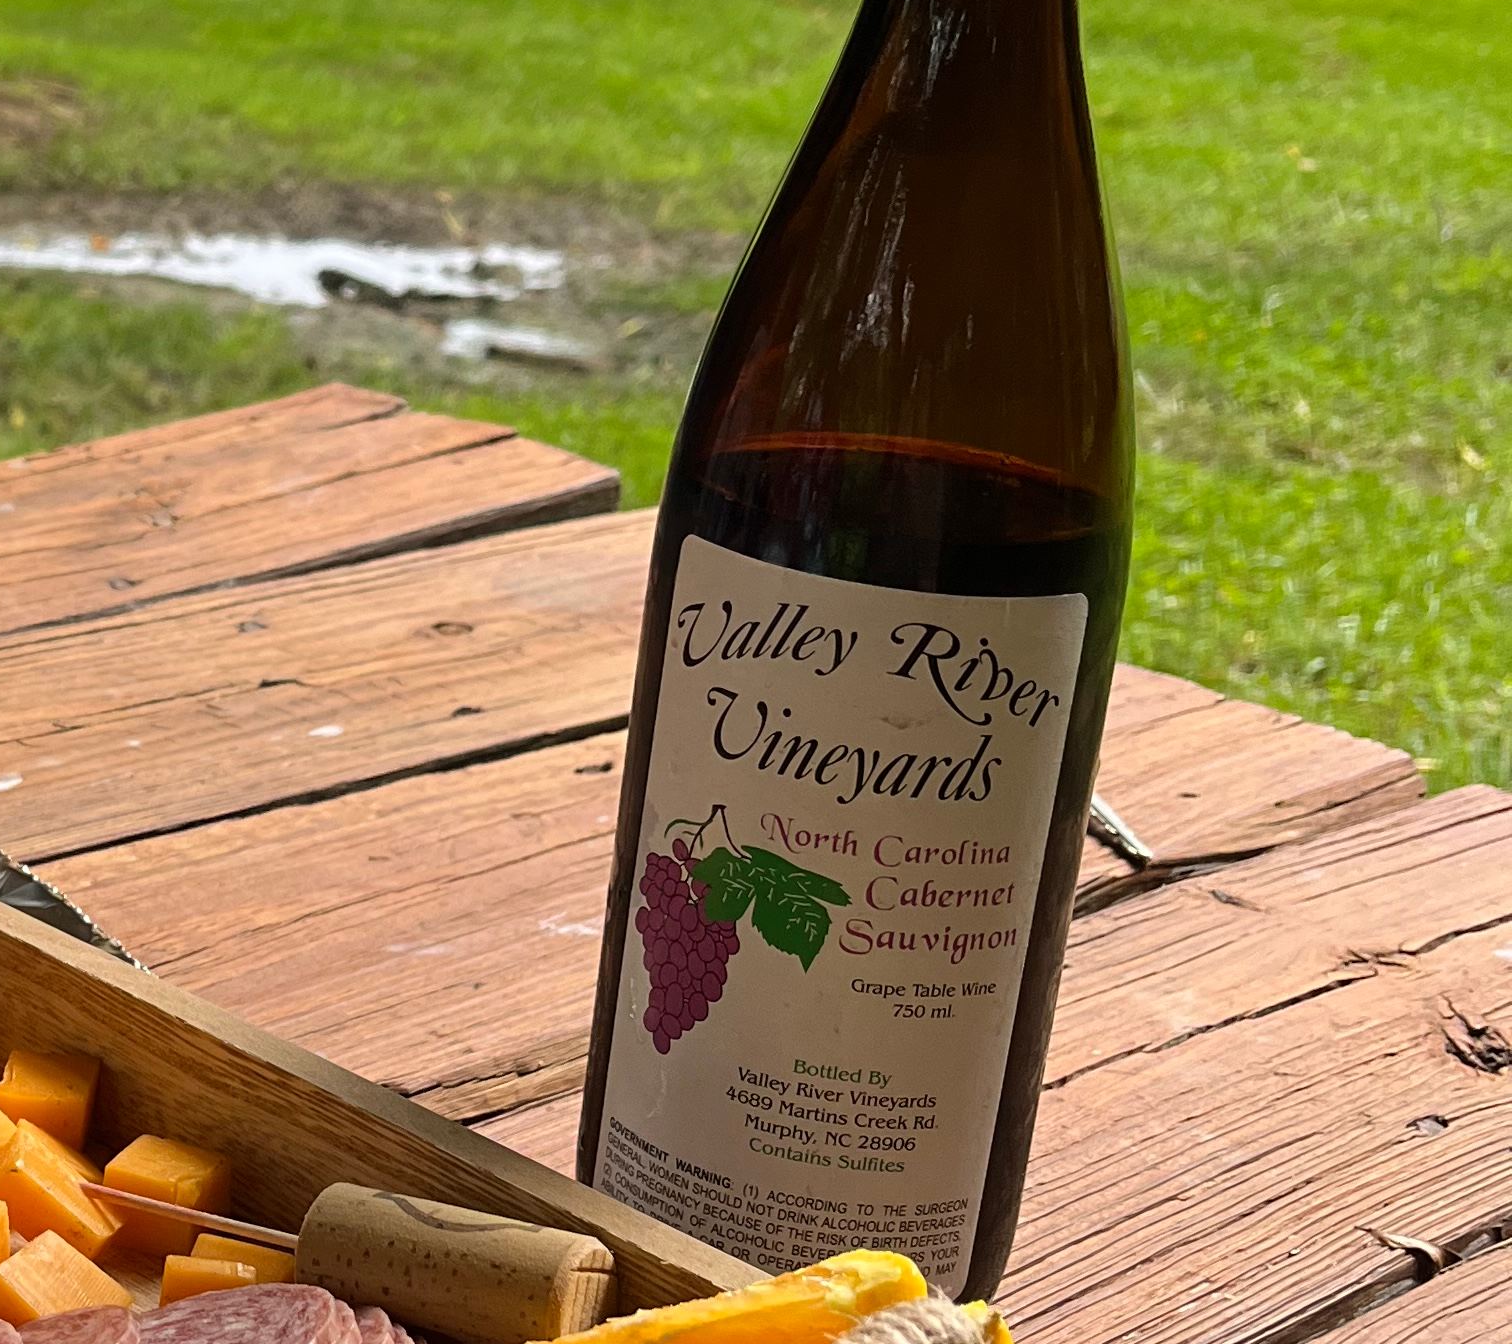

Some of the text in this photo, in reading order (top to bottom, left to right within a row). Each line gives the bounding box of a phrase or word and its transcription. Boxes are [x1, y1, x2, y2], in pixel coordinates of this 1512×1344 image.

[678, 600, 1060, 728] Valley River
[707, 687, 1002, 804] Vineyards
[760, 813, 1011, 867] North Carolina
[865, 876, 1016, 910] Cabernet
[838, 918, 1017, 965] Sauvignon
[851, 978, 997, 998] Grape Table Wine
[892, 1004, 925, 1018] 750
[738, 1067, 937, 1112] Valley River Vineyards
[793, 1059, 892, 1089] Bottled By
[726, 1086, 773, 1111] 4689
[778, 1100, 848, 1126] Martins
[854, 1113, 908, 1130] Creek
[744, 1113, 916, 1152] Murphy, NC 28906
[609, 1116, 968, 1217] GOVERNMENT WARNING: (1) ACCORDING TO THE SURGEON
[749, 1138, 905, 1173] Contains Sulfites
[605, 1146, 635, 1177] DURING
[636, 1169, 701, 1211] PREGNANCY
[702, 1203, 763, 1232] BECAUSE
[765, 1222, 785, 1236] OF
[787, 1226, 814, 1243] THE
[816, 1231, 848, 1247] RISK
[850, 1235, 869, 1248] OF
[871, 1236, 908, 1249] BIRTH
[614, 1171, 685, 1222] CONSUMPTION
[689, 1214, 707, 1229] OF
[710, 1223, 785, 1253] ALCOHOLIC
[930, 1245, 960, 1262] YOUR
[649, 1159, 689, 1191] WOMEN
[692, 1182, 743, 1209] SHOULD
[746, 1200, 774, 1218] NOT
[777, 1208, 819, 1227] DRINK
[820, 1216, 896, 1233] ALCOHOLIC
[898, 1214, 966, 1233] BEVERAGES
[731, 1246, 750, 1262] OR
[935, 1260, 957, 1276] MAY
